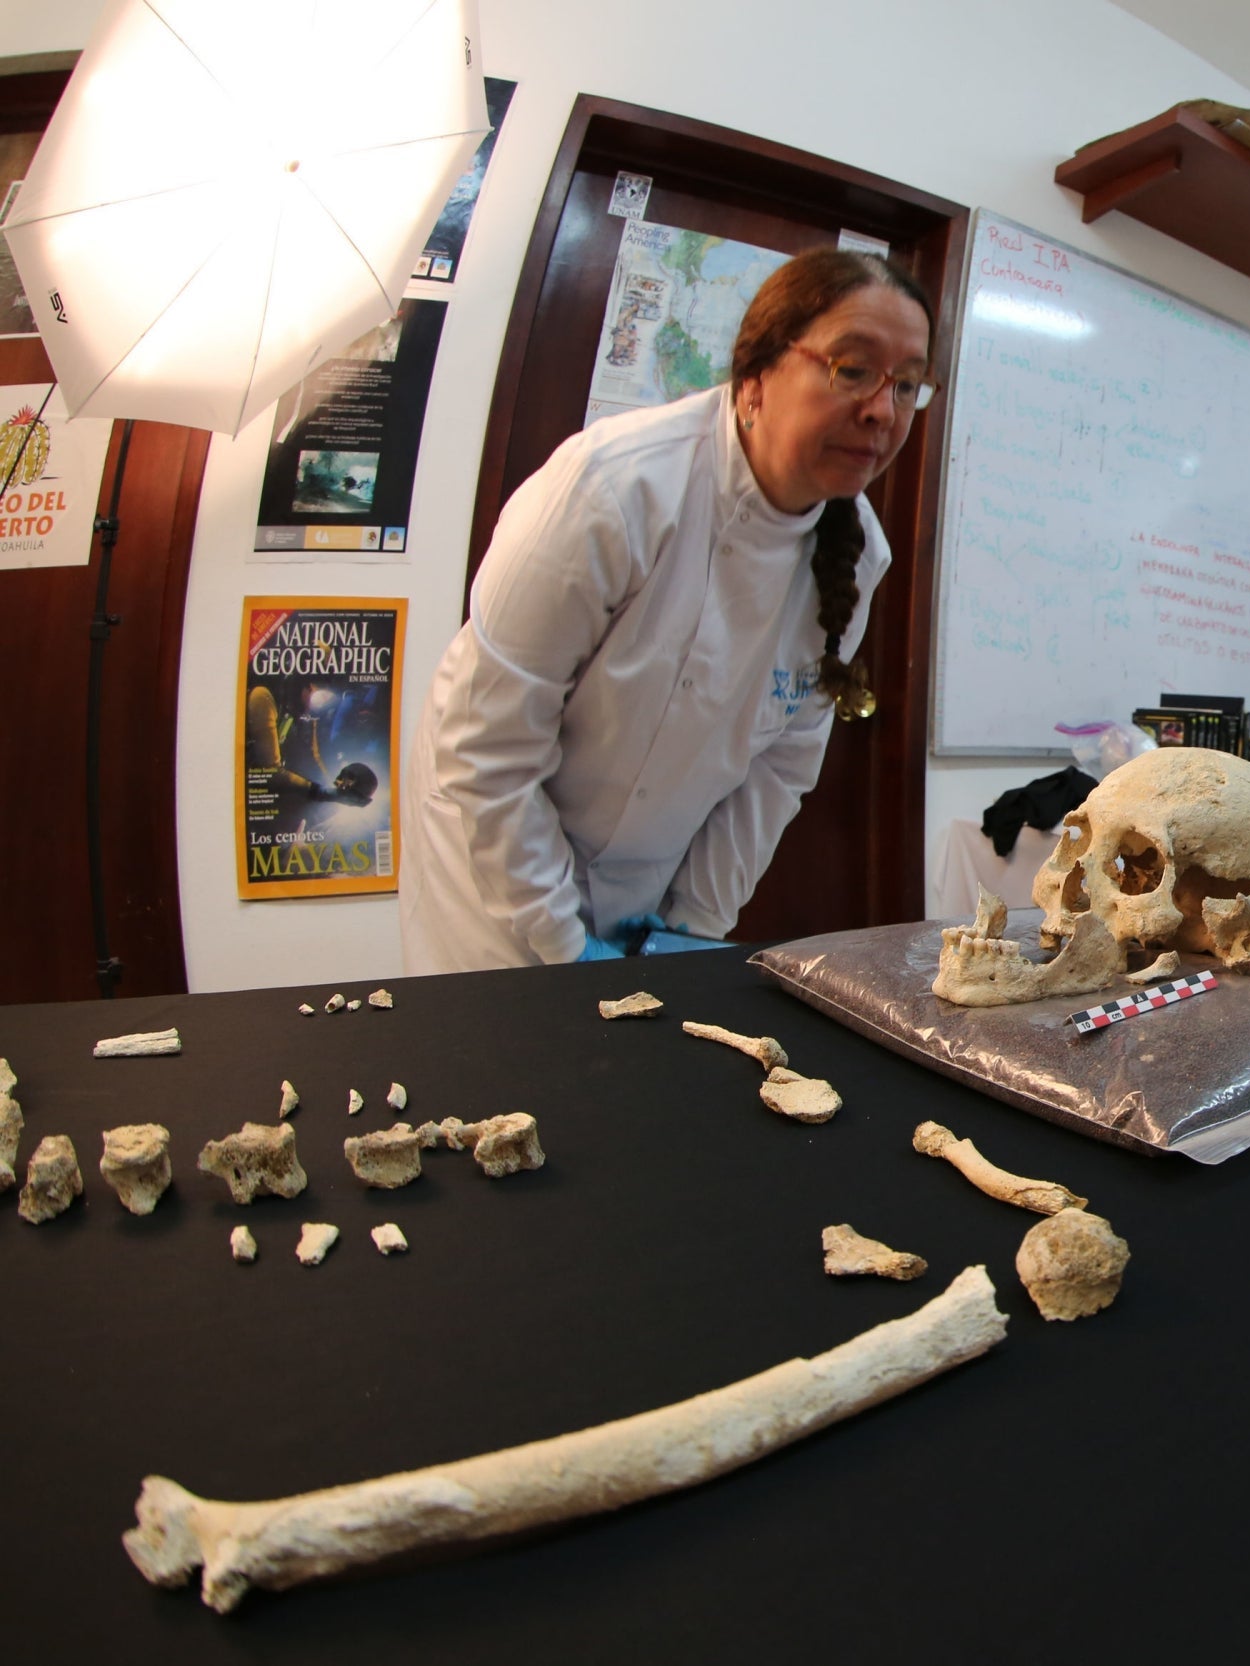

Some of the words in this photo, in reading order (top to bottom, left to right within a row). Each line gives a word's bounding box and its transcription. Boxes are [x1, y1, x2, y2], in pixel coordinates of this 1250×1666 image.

[628, 221, 670, 243] Peopling
[27, 491, 67, 512] DEL
[0, 541, 44, 552] OAHUILA
[276, 621, 373, 647] NATIONAL
[252, 647, 391, 676] GEOGRAPHIC
[349, 675, 359, 683] EN
[360, 674, 388, 682] ESPAÑOL
[251, 832, 272, 845] Los
[275, 830, 325, 843] cenotes
[250, 841, 372, 877] MAYAS
[1111, 1012, 1123, 1020] cm
[1081, 1021, 1091, 1030] 10
